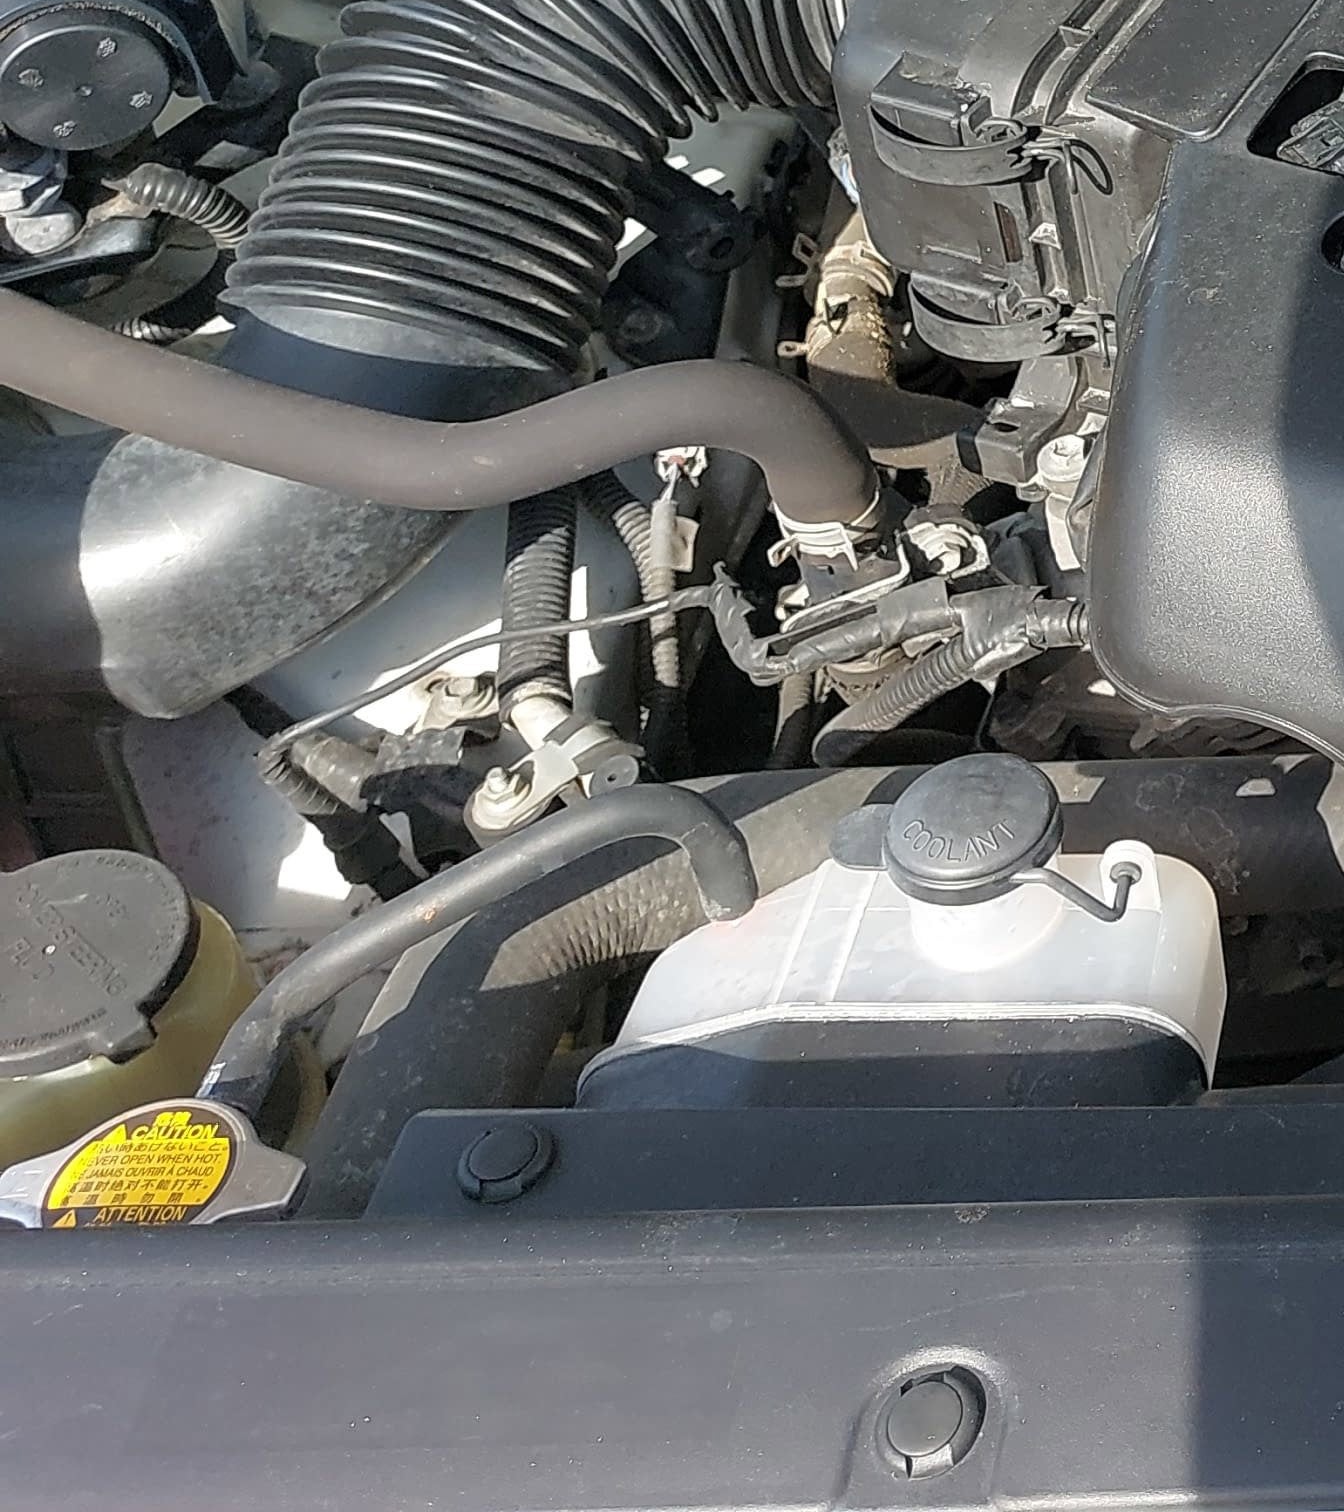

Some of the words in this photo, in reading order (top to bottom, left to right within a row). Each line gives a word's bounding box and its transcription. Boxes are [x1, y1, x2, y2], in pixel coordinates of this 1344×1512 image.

[903, 818, 1015, 862] COOLANT
[131, 1124, 219, 1140] CAUTION
[121, 1154, 155, 1166] OPEN
[156, 1153, 193, 1165] WHEN
[86, 1167, 123, 1180] JAMAIS
[125, 1166, 164, 1178] OUVRIR
[93, 1205, 189, 1224] ATTENTION
